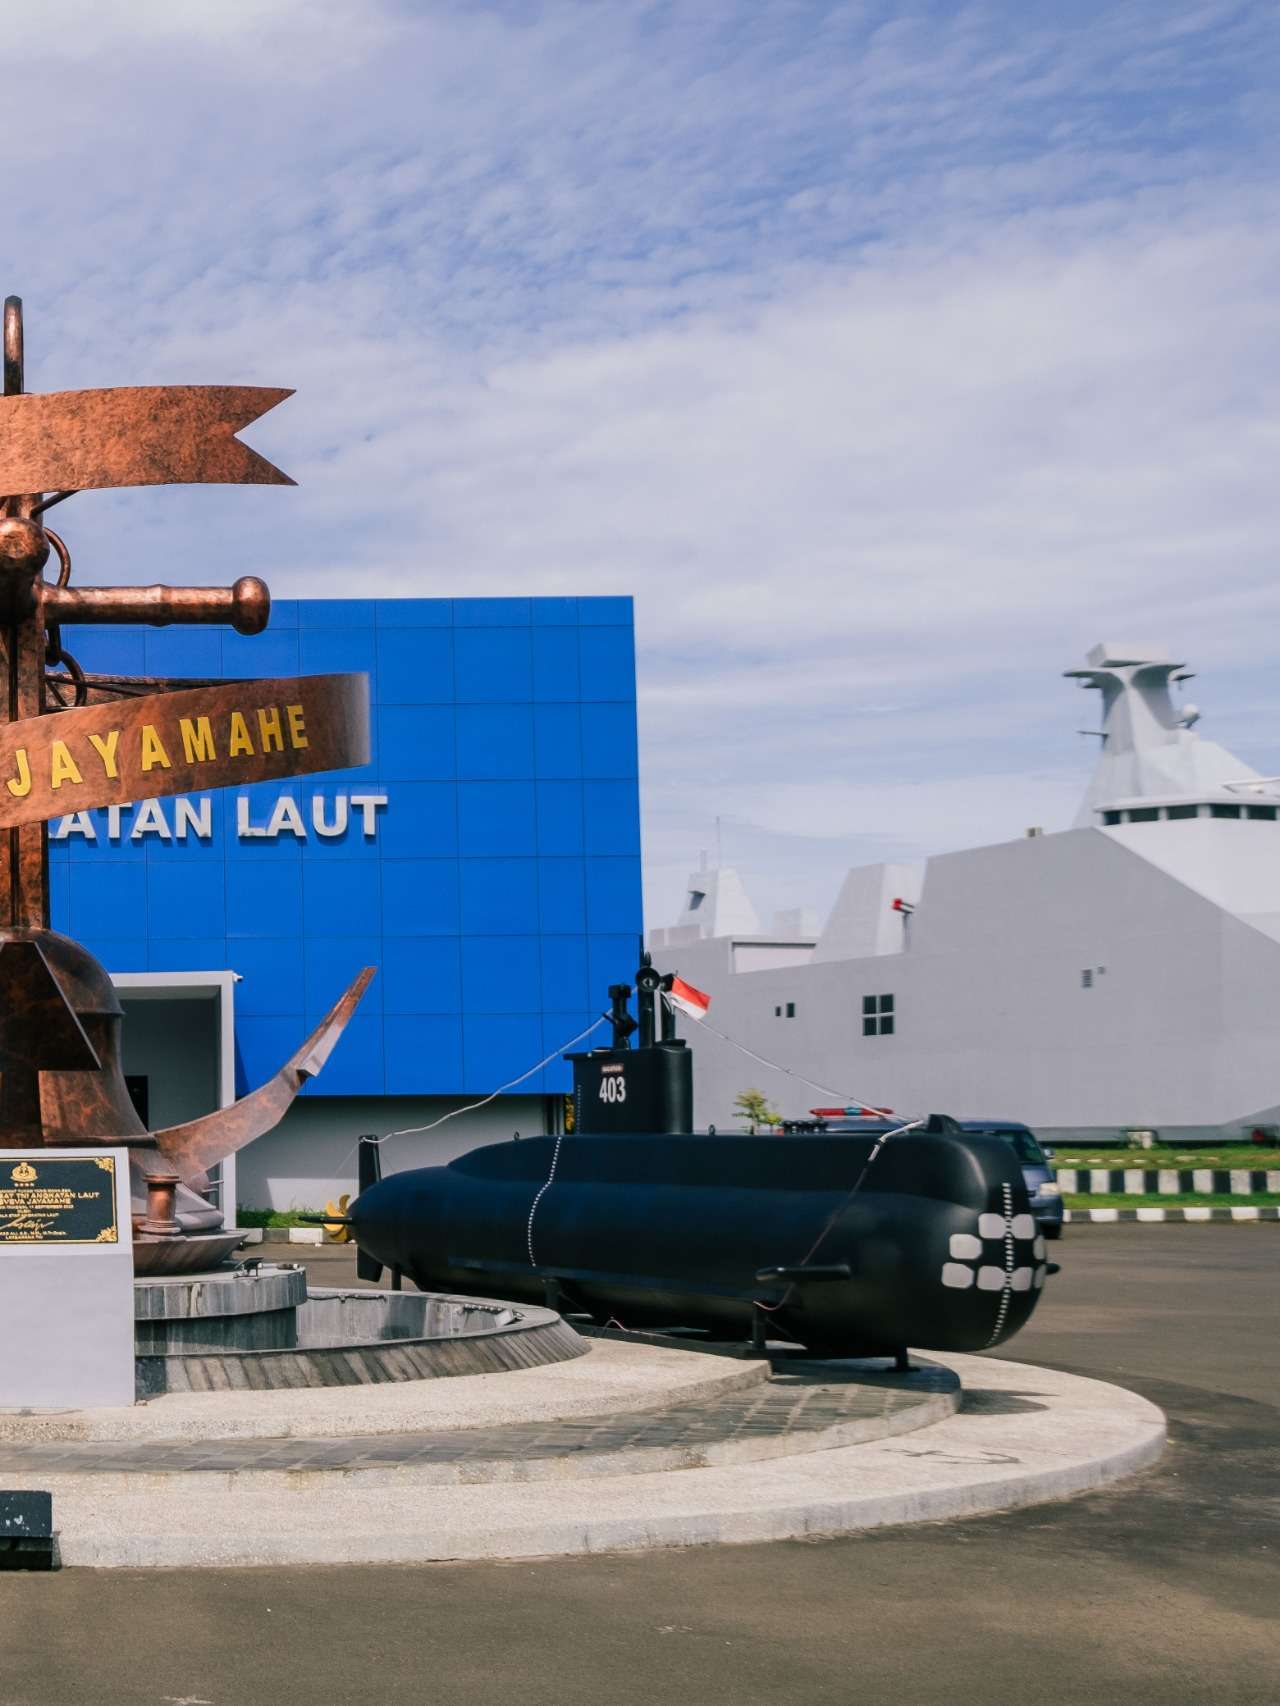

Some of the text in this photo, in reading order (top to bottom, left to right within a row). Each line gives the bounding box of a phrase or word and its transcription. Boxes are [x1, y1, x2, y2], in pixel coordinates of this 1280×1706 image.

[5, 704, 310, 797] JAYAMAHE
[48, 795, 388, 838] ATAN LAUT
[599, 1076, 627, 1103] 403
[16, 1192, 30, 1200] TNI
[77, 1191, 100, 1199] LAUT
